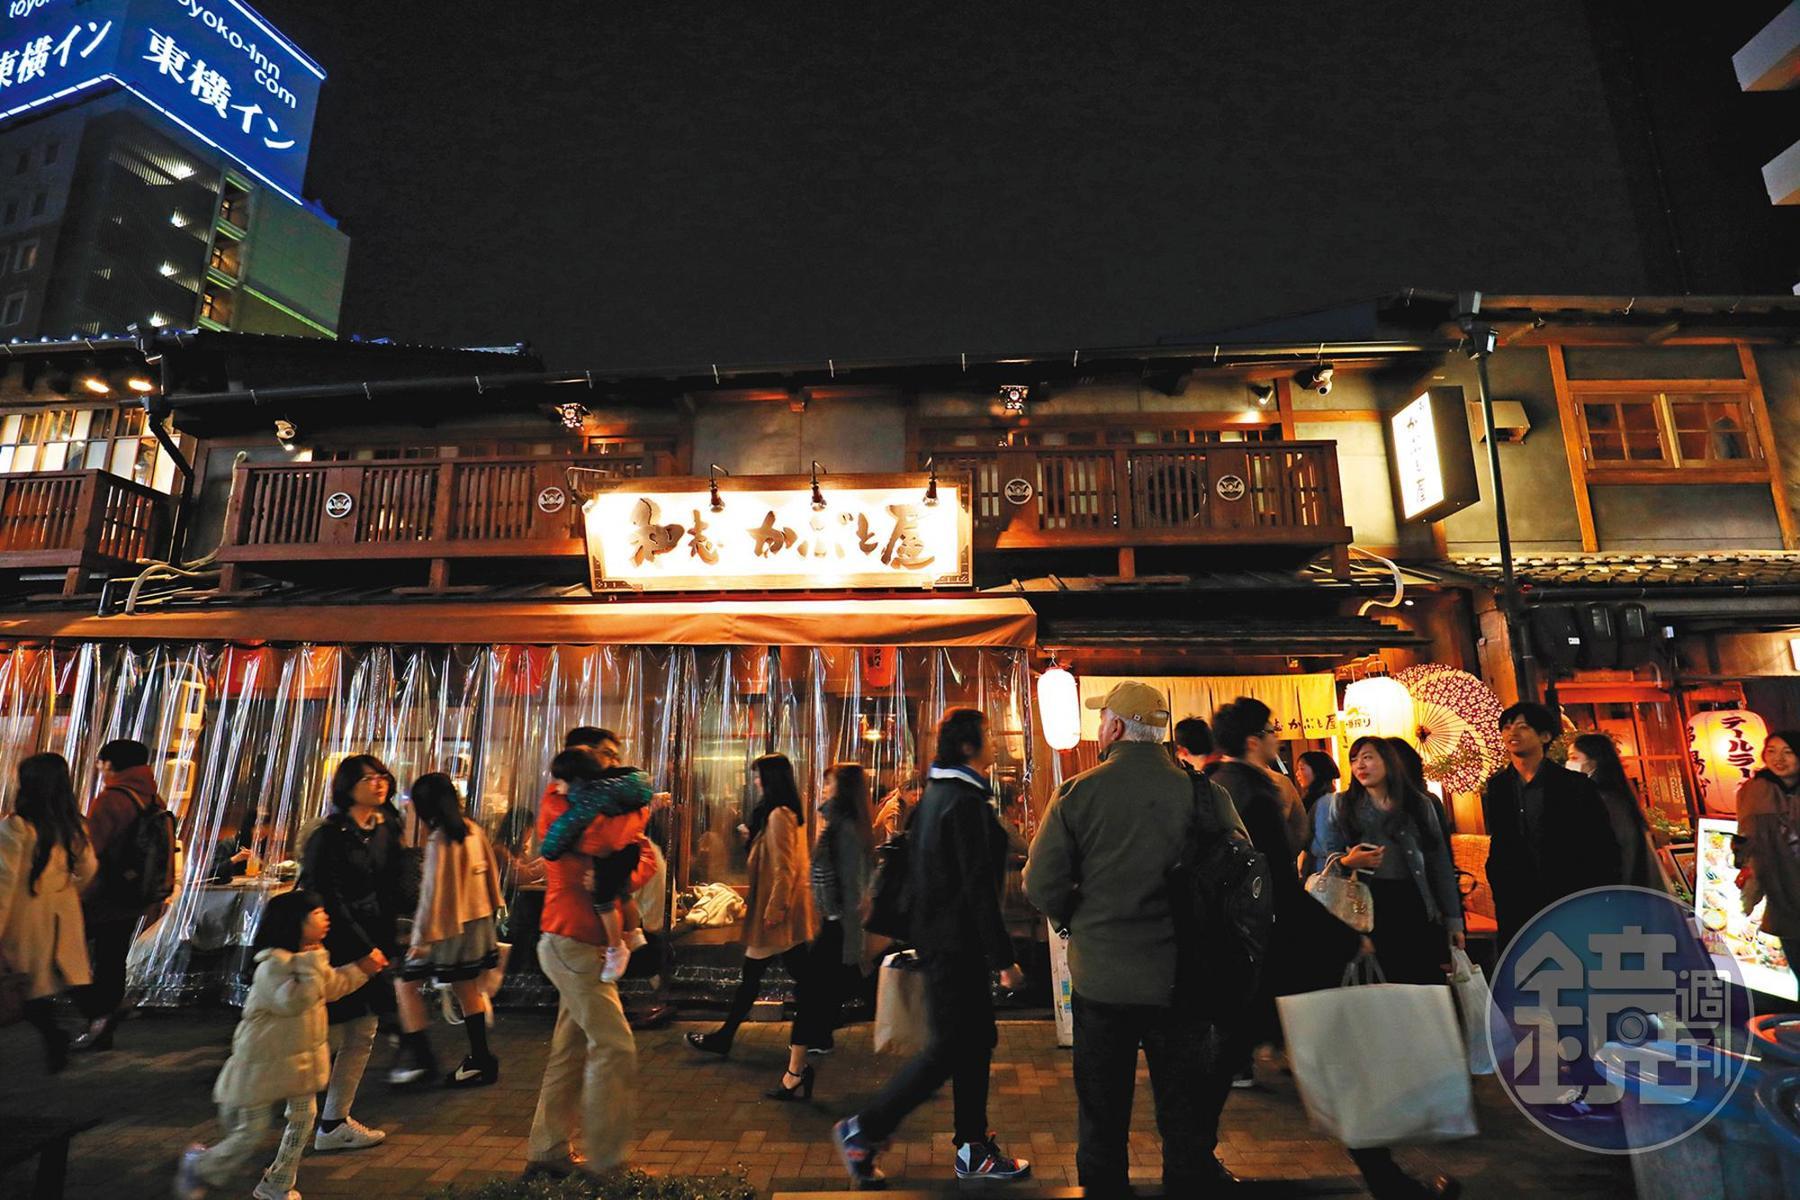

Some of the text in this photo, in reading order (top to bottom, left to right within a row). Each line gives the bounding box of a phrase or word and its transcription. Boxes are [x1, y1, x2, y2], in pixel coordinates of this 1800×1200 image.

[9, 0, 50, 18] toyo
[142, 28, 296, 149] 東横イン
[254, 69, 297, 109] com
[1720, 716, 1755, 785] テールラー
